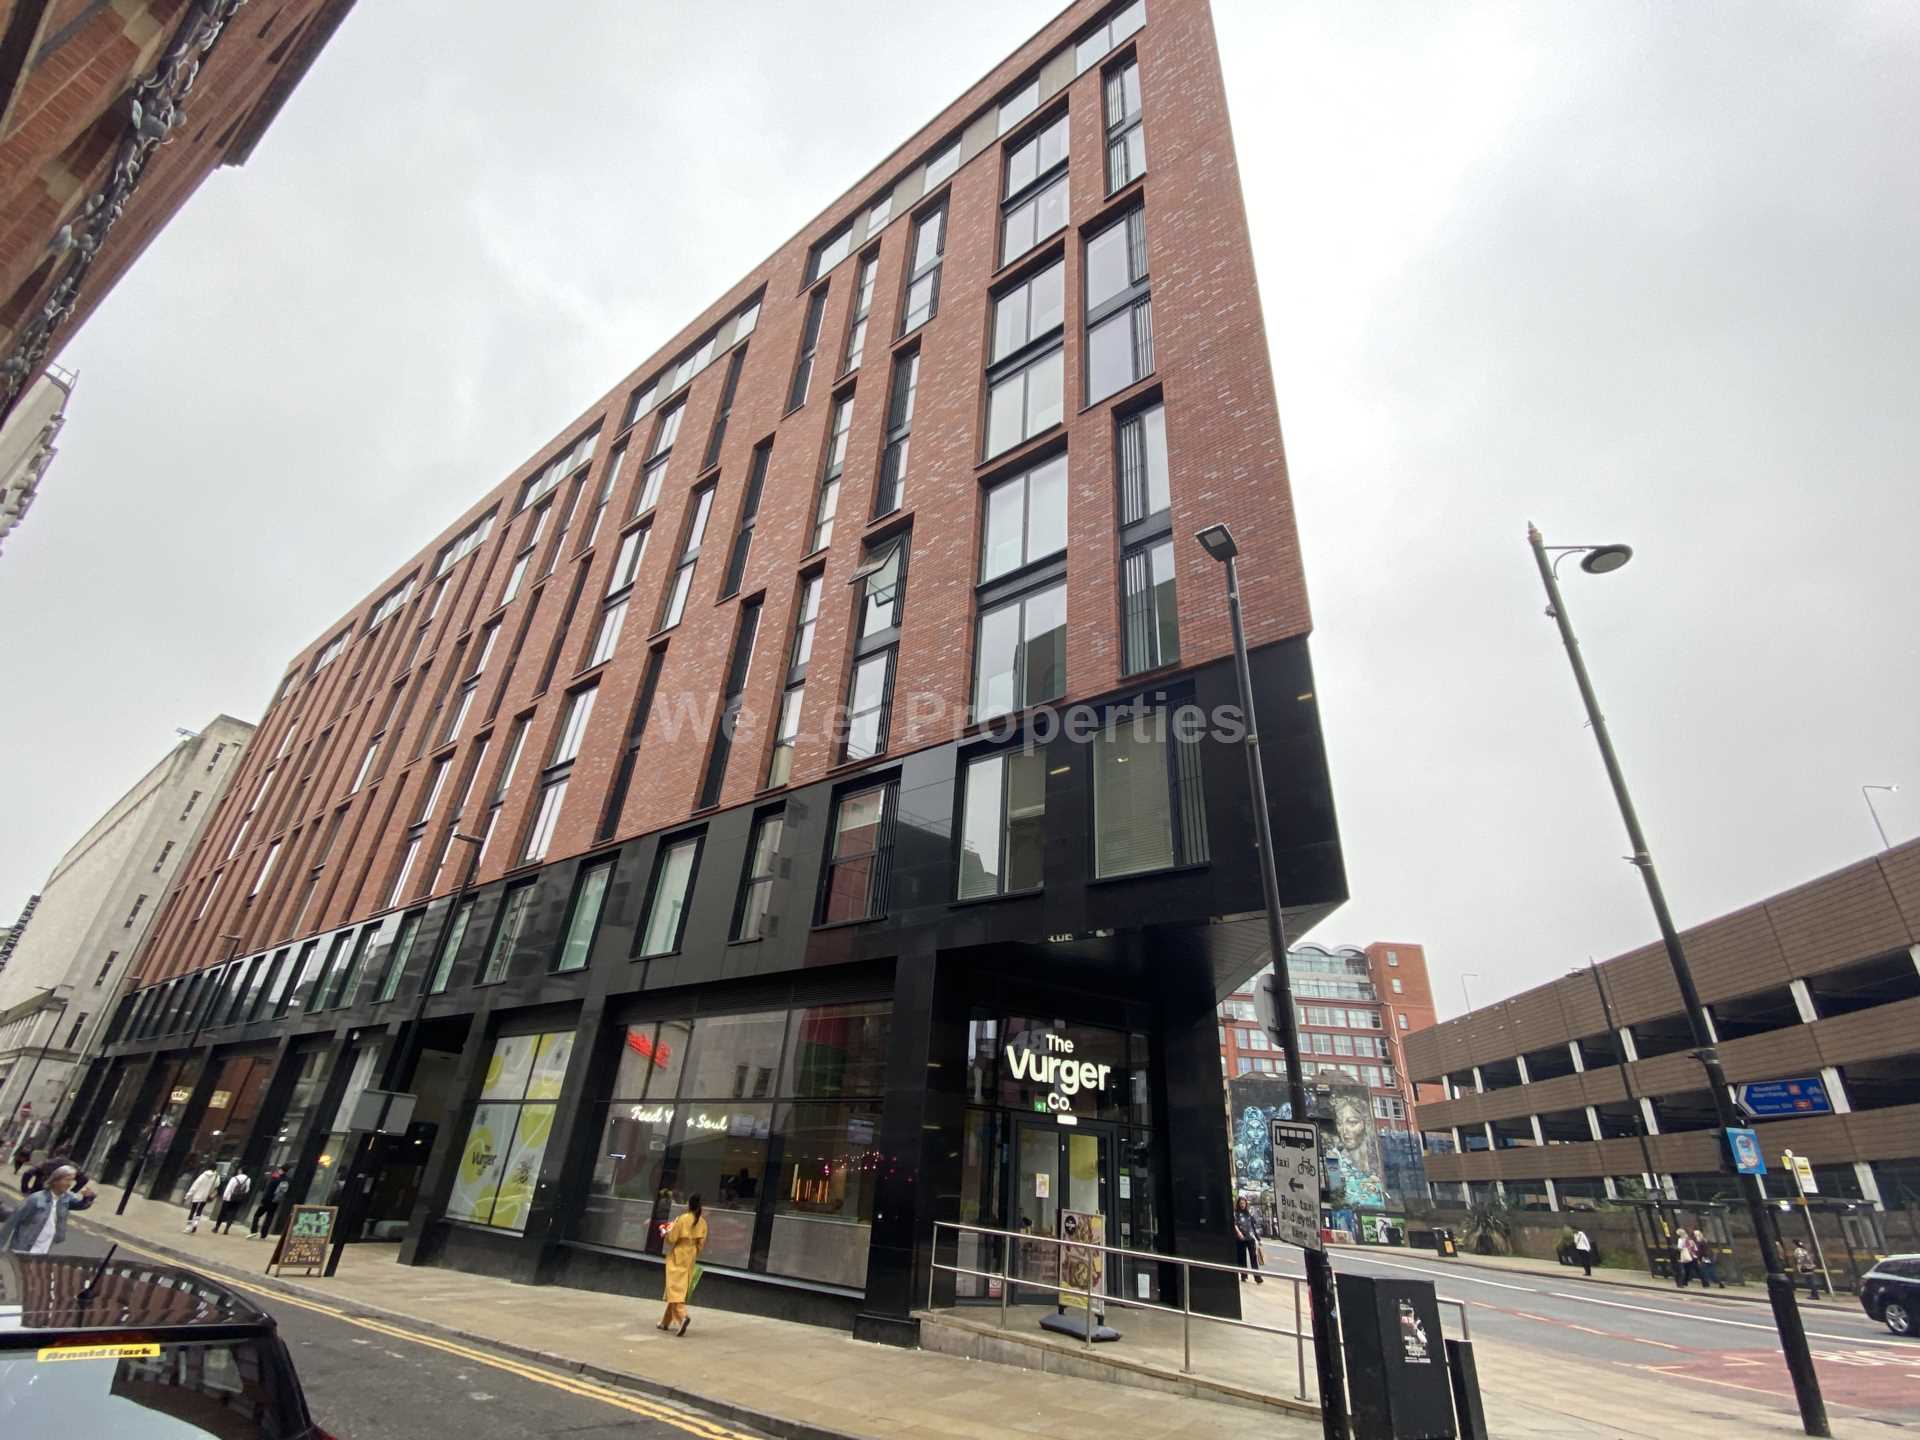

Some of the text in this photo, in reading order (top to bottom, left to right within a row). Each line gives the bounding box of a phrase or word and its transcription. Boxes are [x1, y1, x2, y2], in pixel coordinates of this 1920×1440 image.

[1046, 1033, 1074, 1053] The
[1006, 1045, 1111, 1095] Vurger
[1047, 1092, 1072, 1111] Co.
[630, 1105, 662, 1123] Feed
[696, 1113, 728, 1131] Soul
[1276, 1155, 1290, 1168] taxi
[45, 1347, 152, 1360] Arnold Clark
